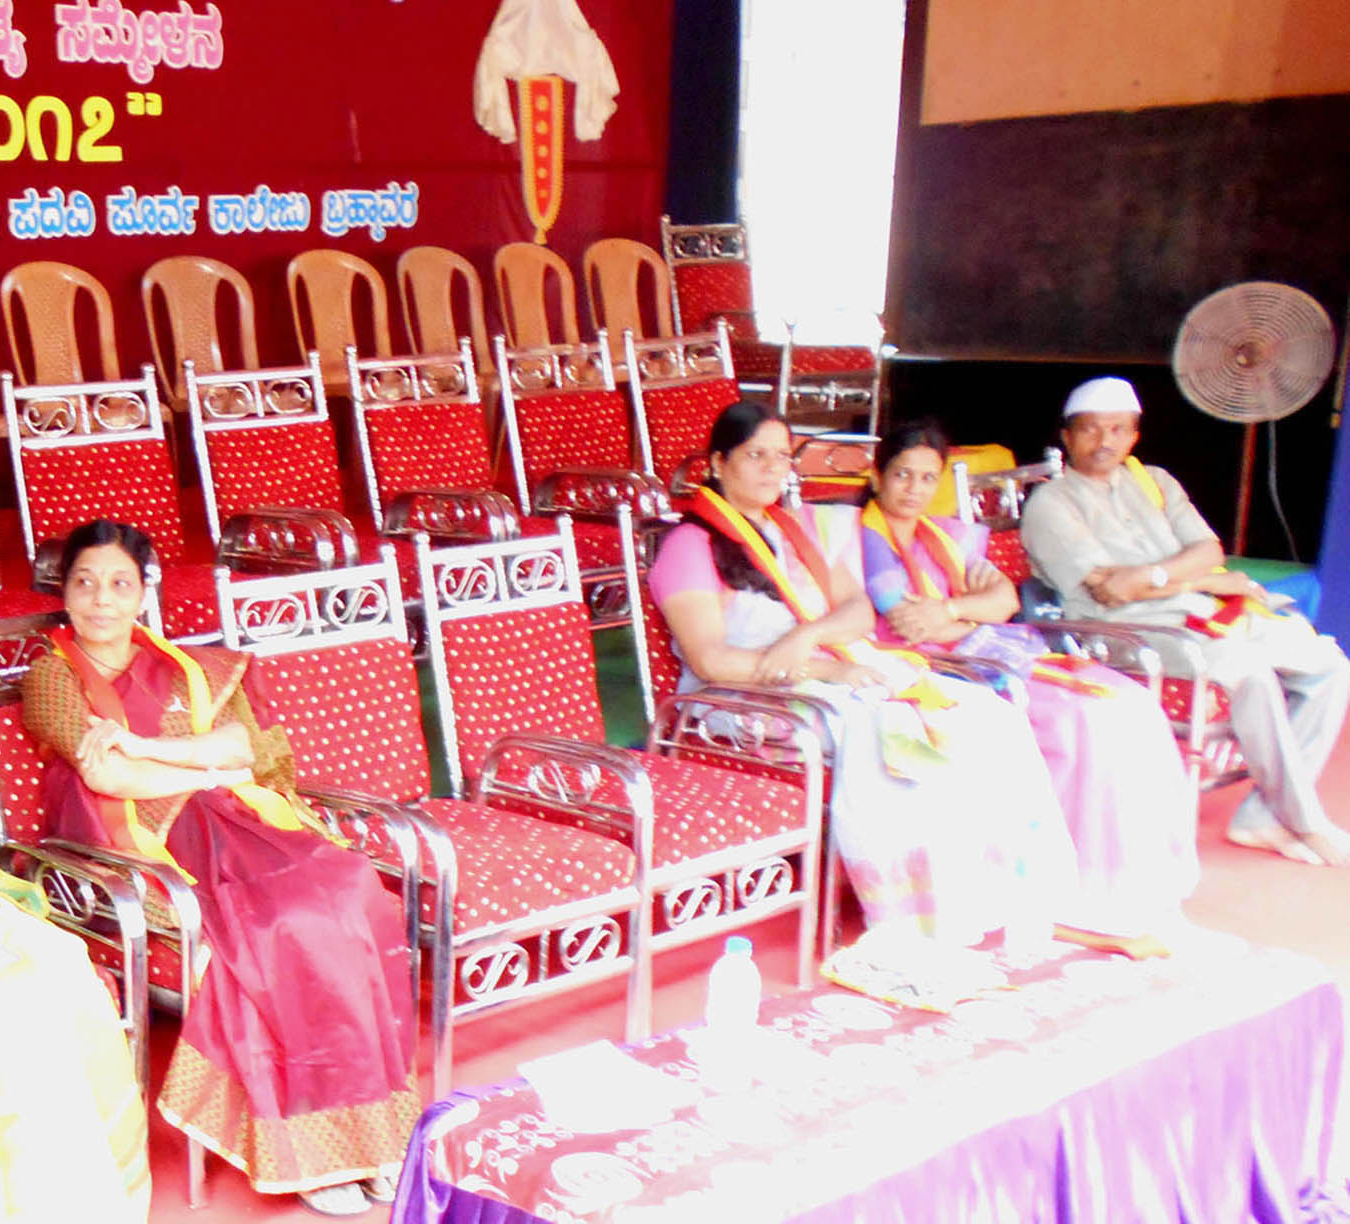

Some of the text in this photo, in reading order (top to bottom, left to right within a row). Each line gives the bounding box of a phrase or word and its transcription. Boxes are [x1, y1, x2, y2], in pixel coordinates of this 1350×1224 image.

[55, 0, 223, 84] ಸಮ್ಮೇಳನ
[9, 187, 96, 239] ಪದವಿ
[106, 186, 199, 235] ಪೂರ್ವ
